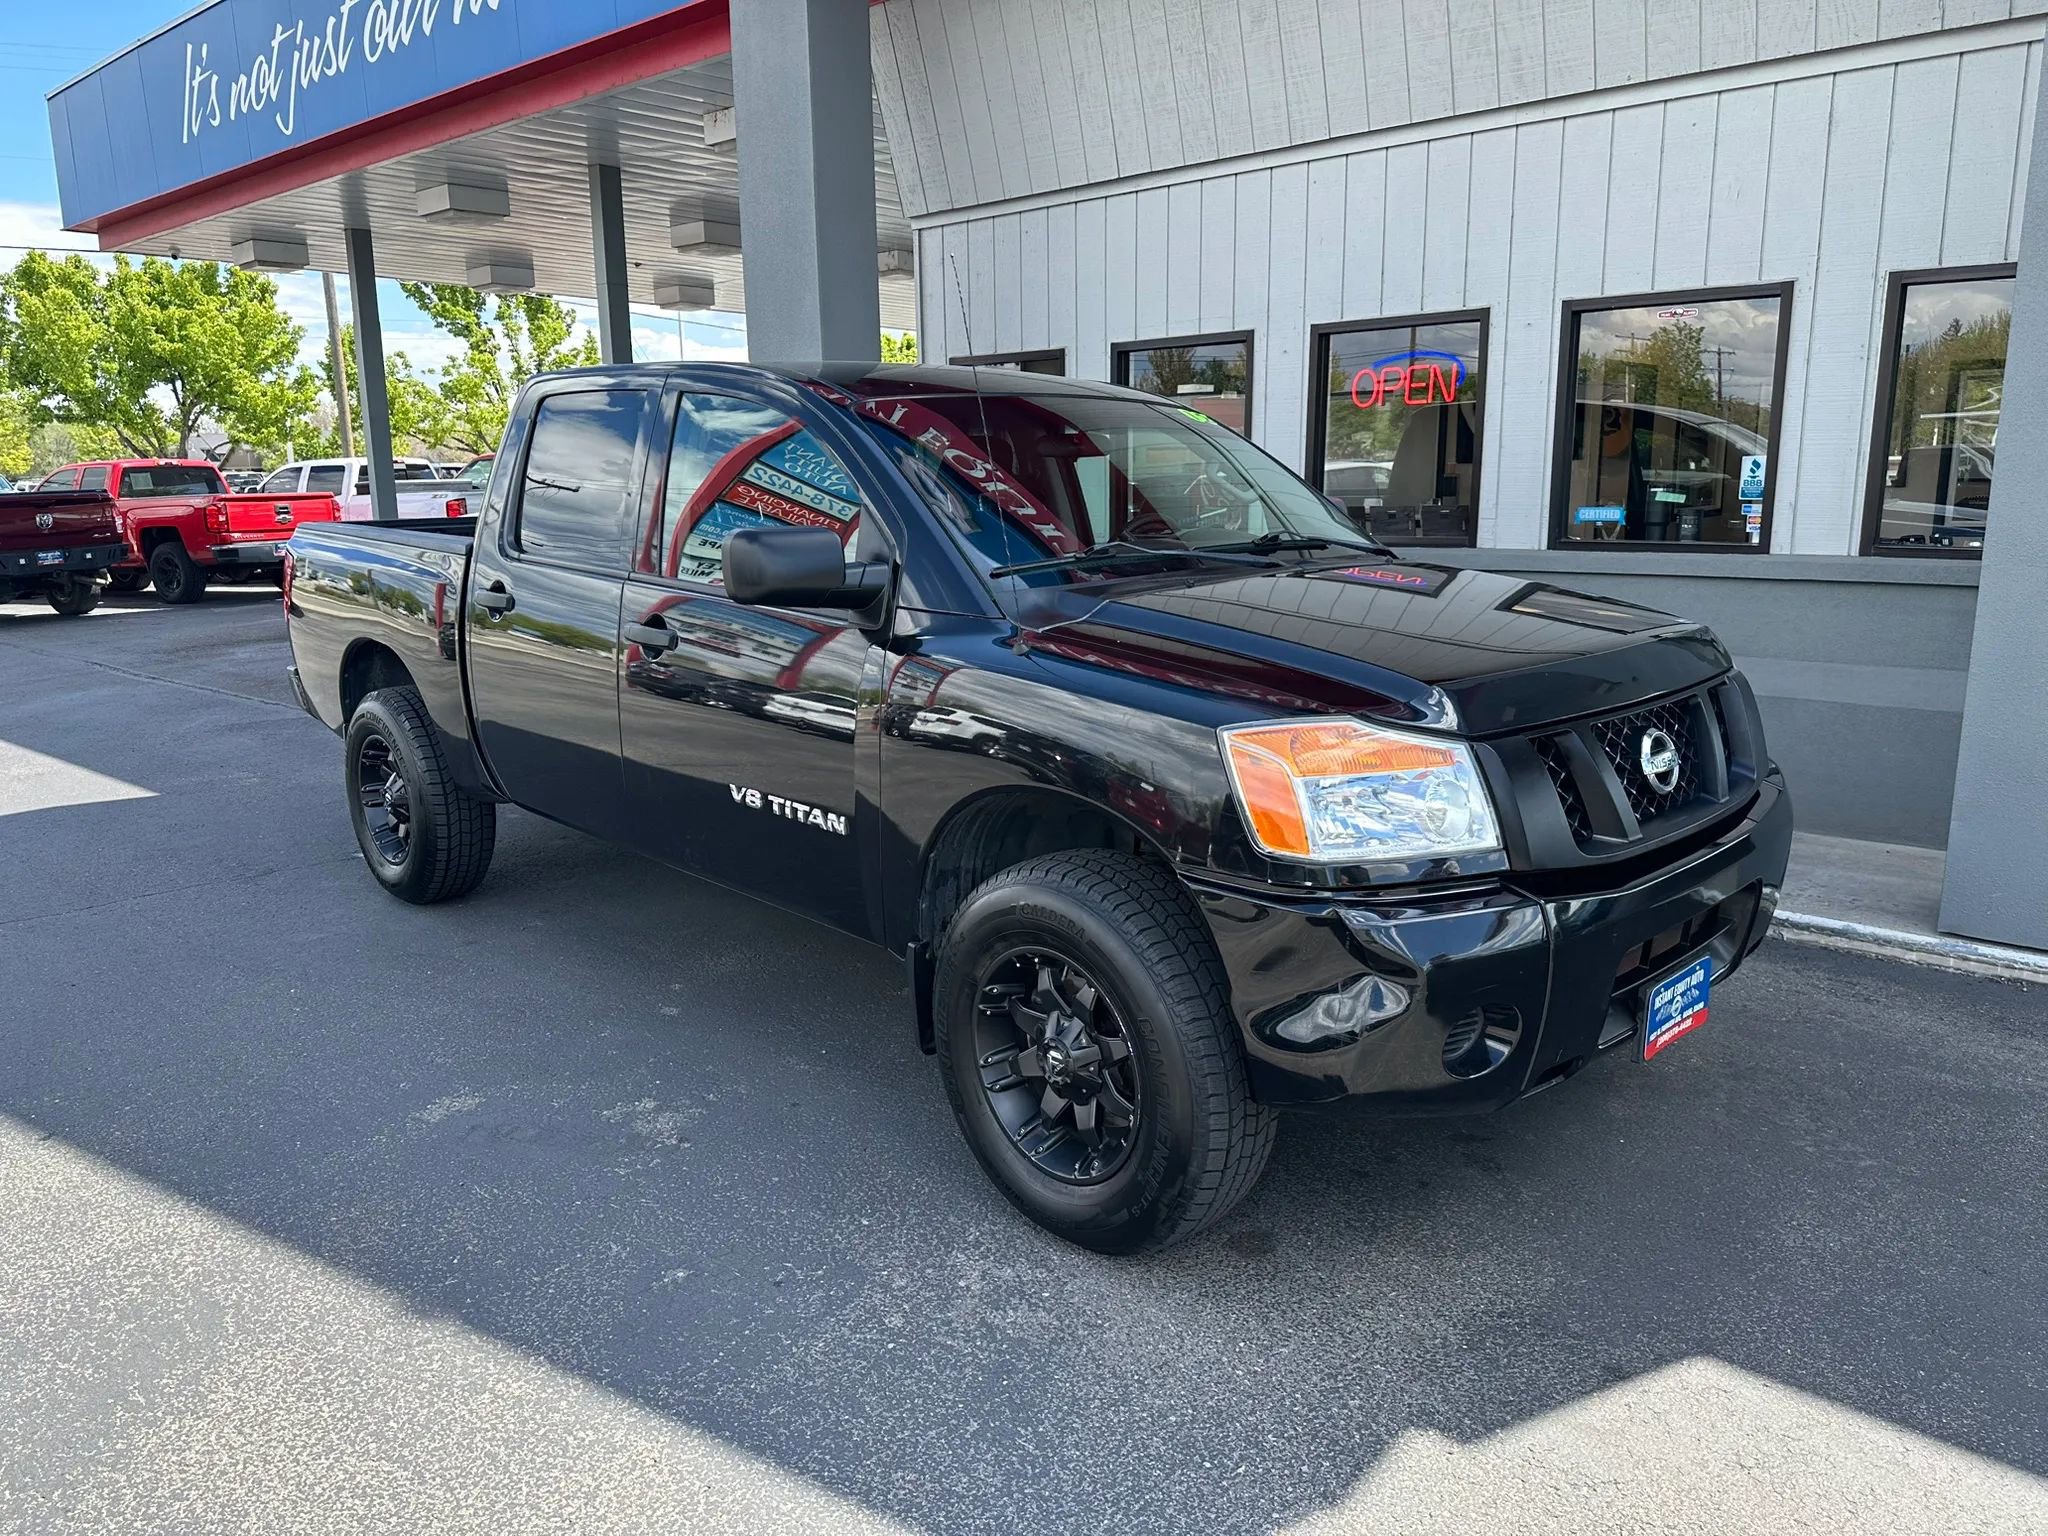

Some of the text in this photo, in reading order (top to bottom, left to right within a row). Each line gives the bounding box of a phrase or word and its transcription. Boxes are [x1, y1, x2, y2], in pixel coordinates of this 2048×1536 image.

[182, 42, 220, 144] It's
[230, 22, 296, 121] not
[275, 0, 354, 136] just
[1351, 362, 1458, 409] OPEN
[1743, 479, 1762, 487] BBB
[1579, 509, 1620, 519] CERTIFIED
[729, 783, 850, 836] V8 TITAN
